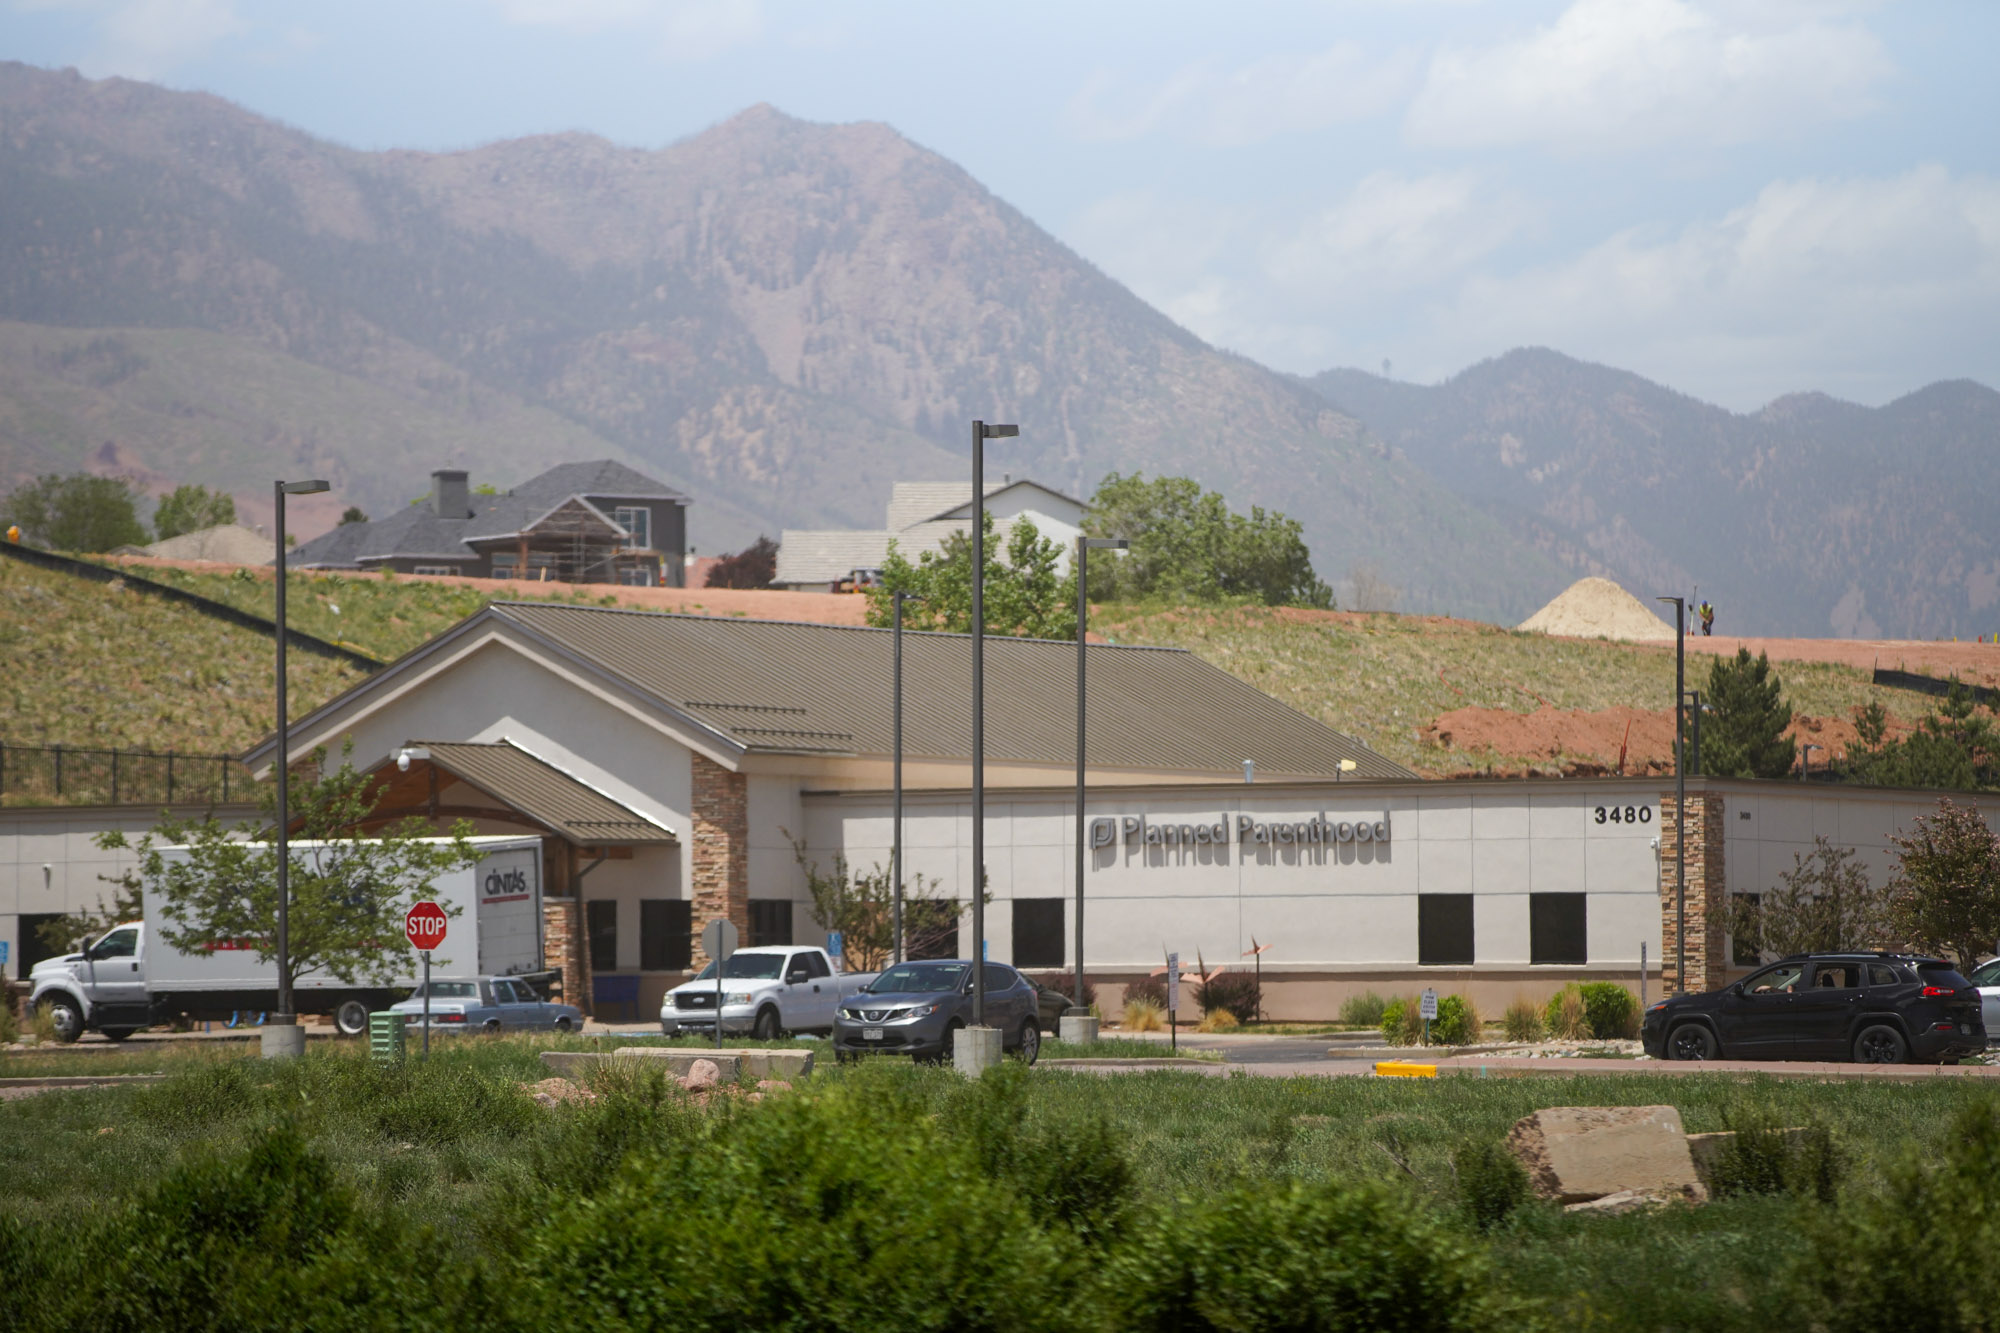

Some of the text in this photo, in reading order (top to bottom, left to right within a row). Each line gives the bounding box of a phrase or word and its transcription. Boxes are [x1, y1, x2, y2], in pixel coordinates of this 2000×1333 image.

[1594, 805, 1652, 825] 3480
[1121, 812, 1229, 845] Planned
[1236, 809, 1392, 844] Parenthood
[408, 916, 446, 936] STOP
